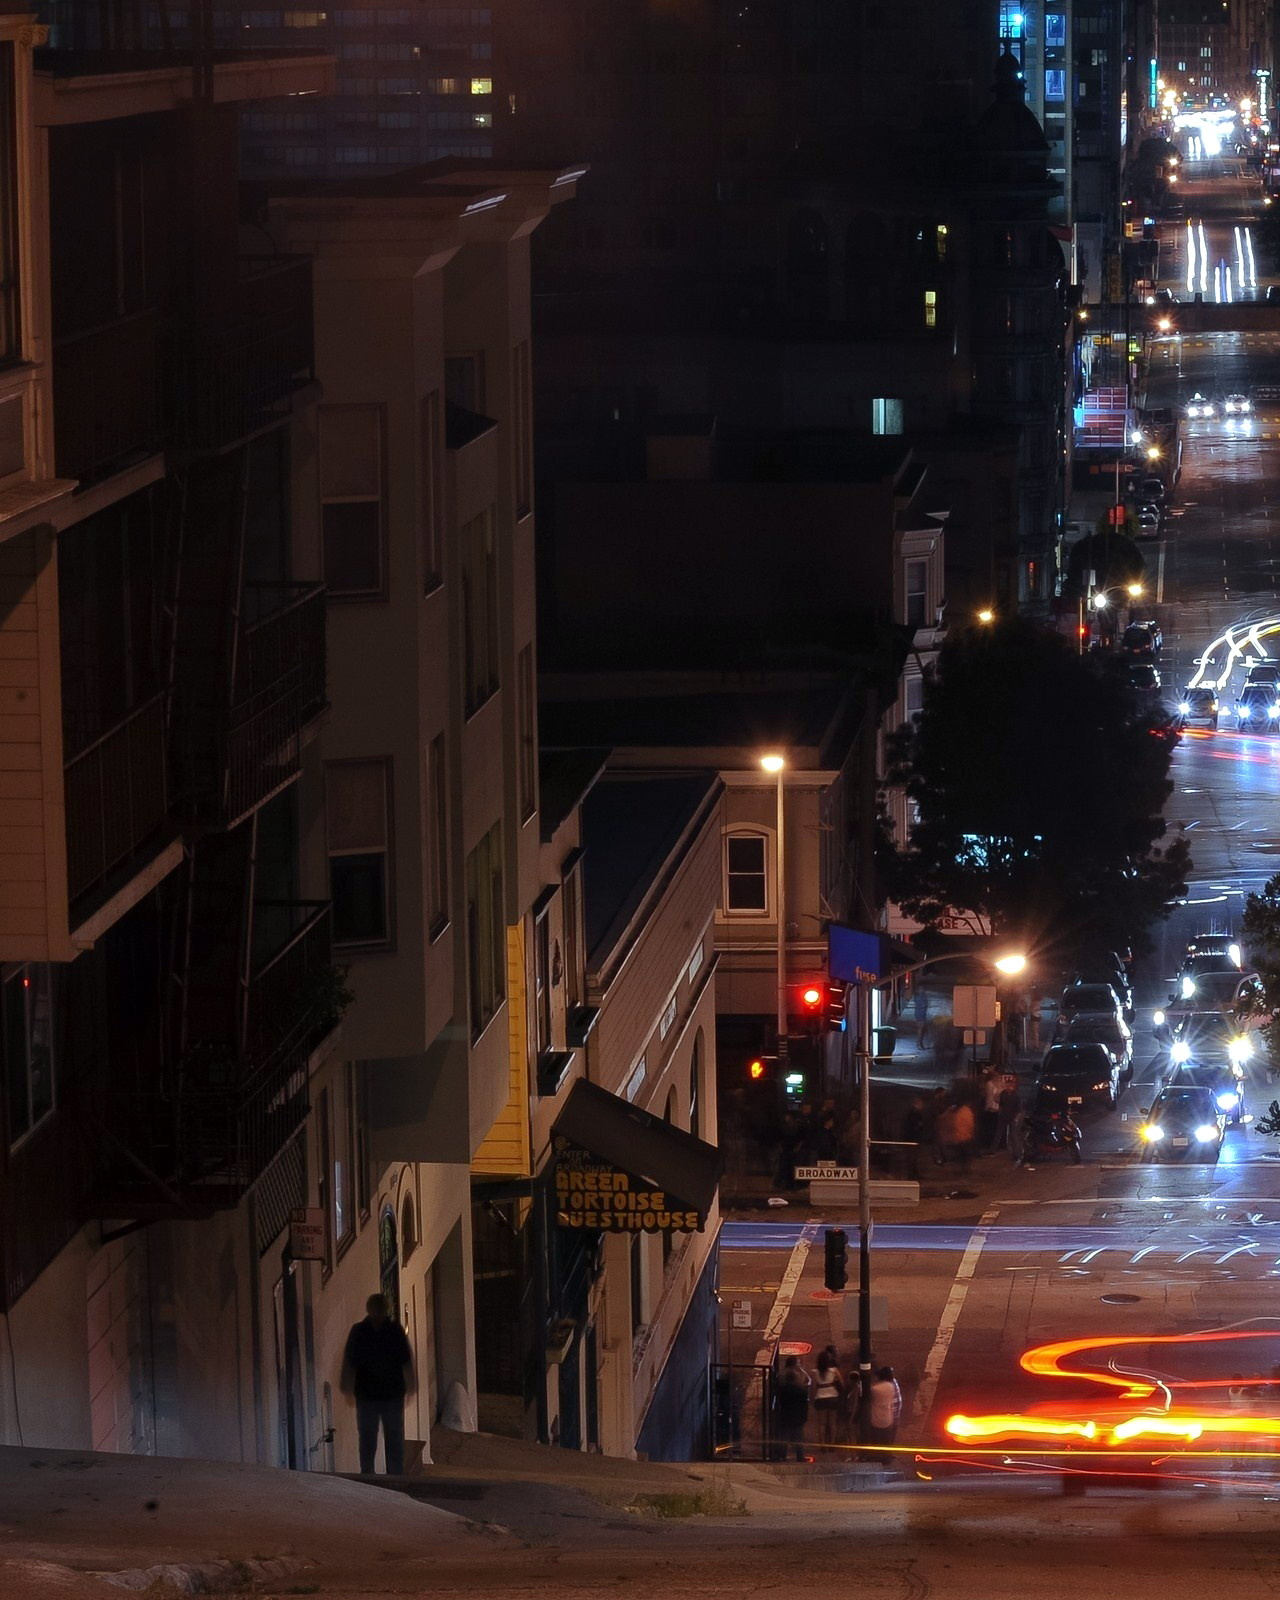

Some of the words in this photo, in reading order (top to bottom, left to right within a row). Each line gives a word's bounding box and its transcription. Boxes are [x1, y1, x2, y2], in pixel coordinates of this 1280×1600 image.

[855, 966, 877, 983] fuse
[556, 1150, 591, 1160] ENTER
[556, 1163, 613, 1173] BROADWAY
[798, 1169, 856, 1178] BROADWAY
[556, 1192, 665, 1210] TORTOISE
[292, 1209, 305, 1222] NO
[558, 1211, 699, 1228] GUESTHOUSE
[292, 1225, 323, 1235] PARKING
